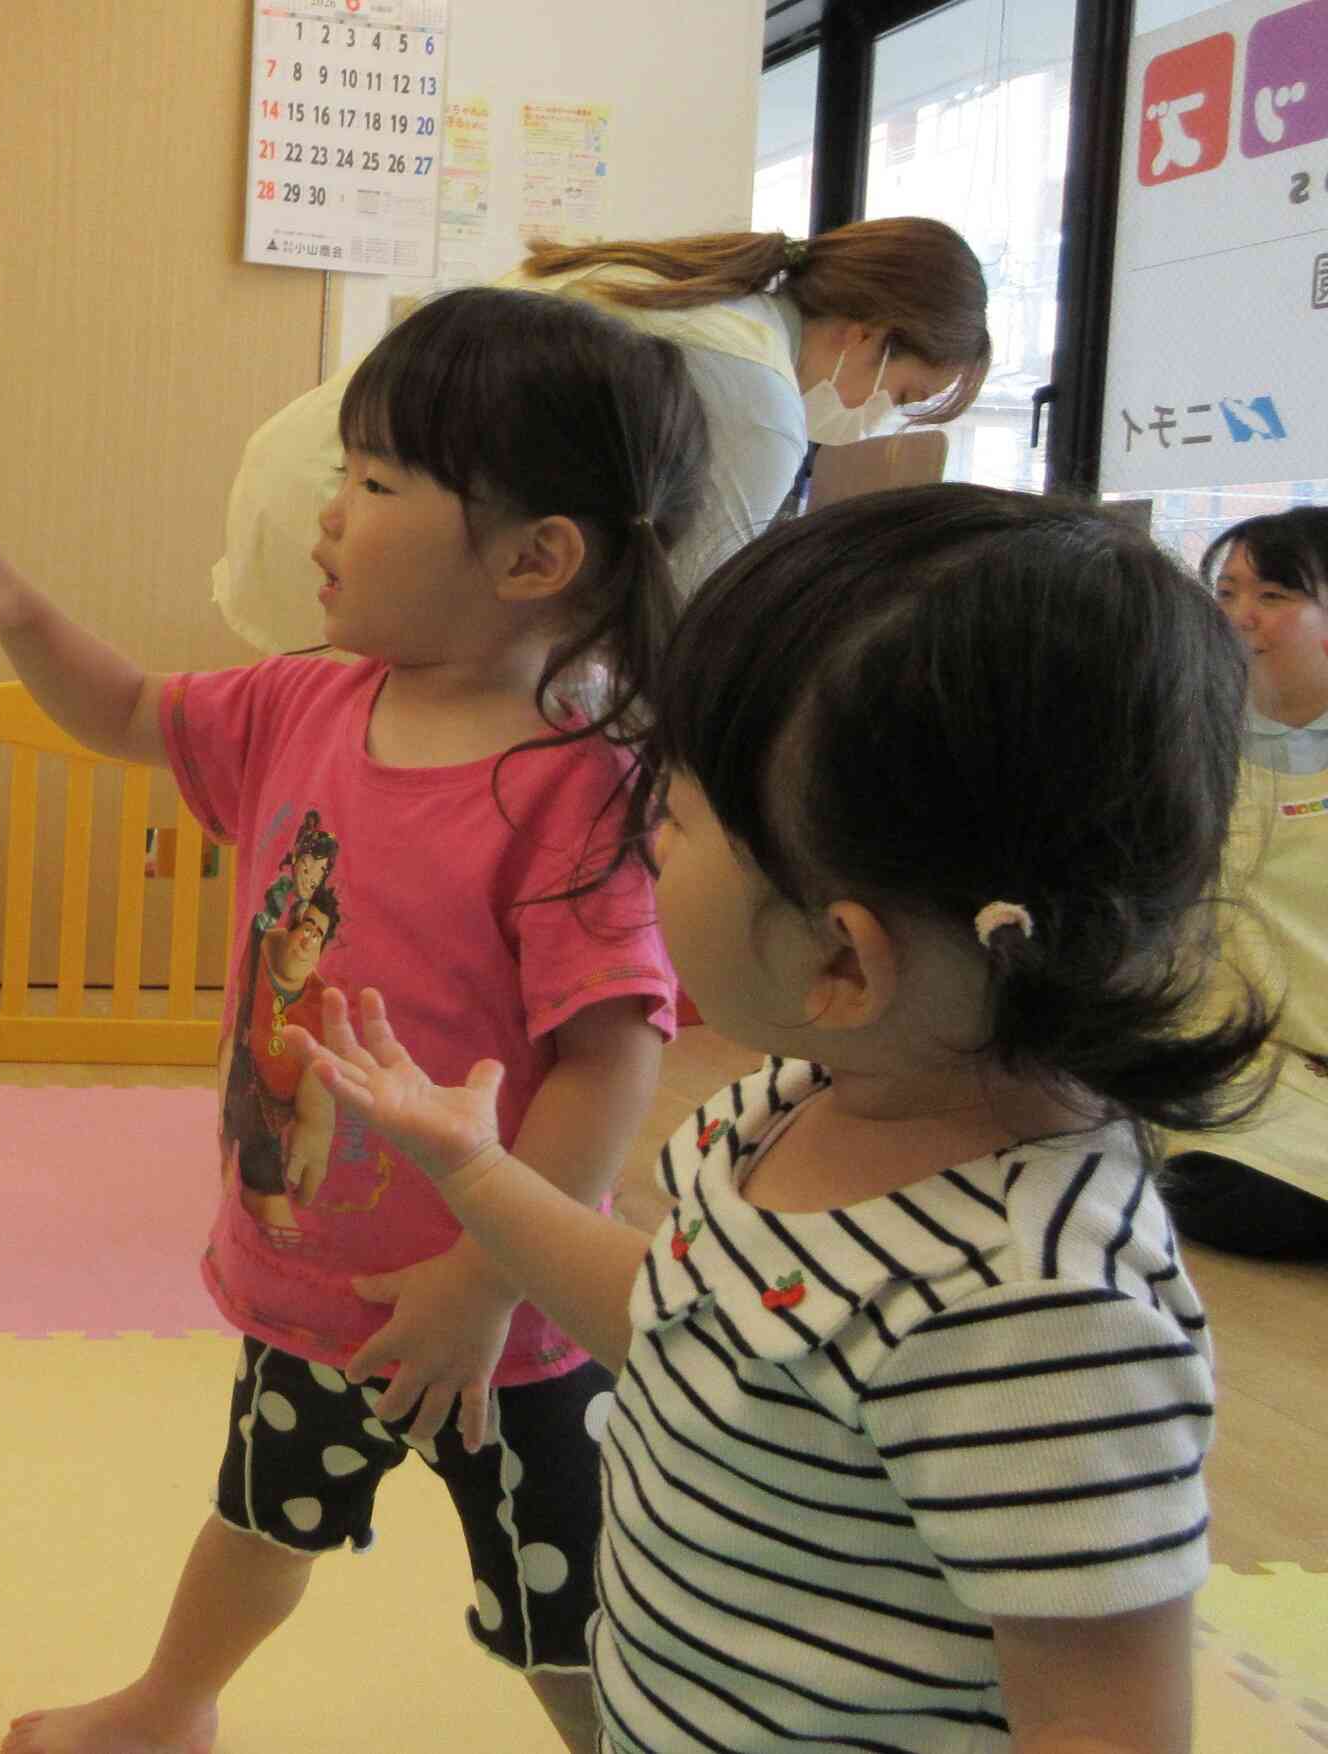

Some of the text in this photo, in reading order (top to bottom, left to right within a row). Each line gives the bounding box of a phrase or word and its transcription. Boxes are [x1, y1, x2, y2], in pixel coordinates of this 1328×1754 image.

[295, 22, 435, 55] 1 2 3 4 5 6
[266, 59, 437, 96] 7 8 9 10 11 12 13
[261, 100, 435, 136] 14 15 16 17 18 19 20
[259, 140, 434, 175] 21 22 23 24 25 26 27
[256, 180, 326, 206] 28 29 30
